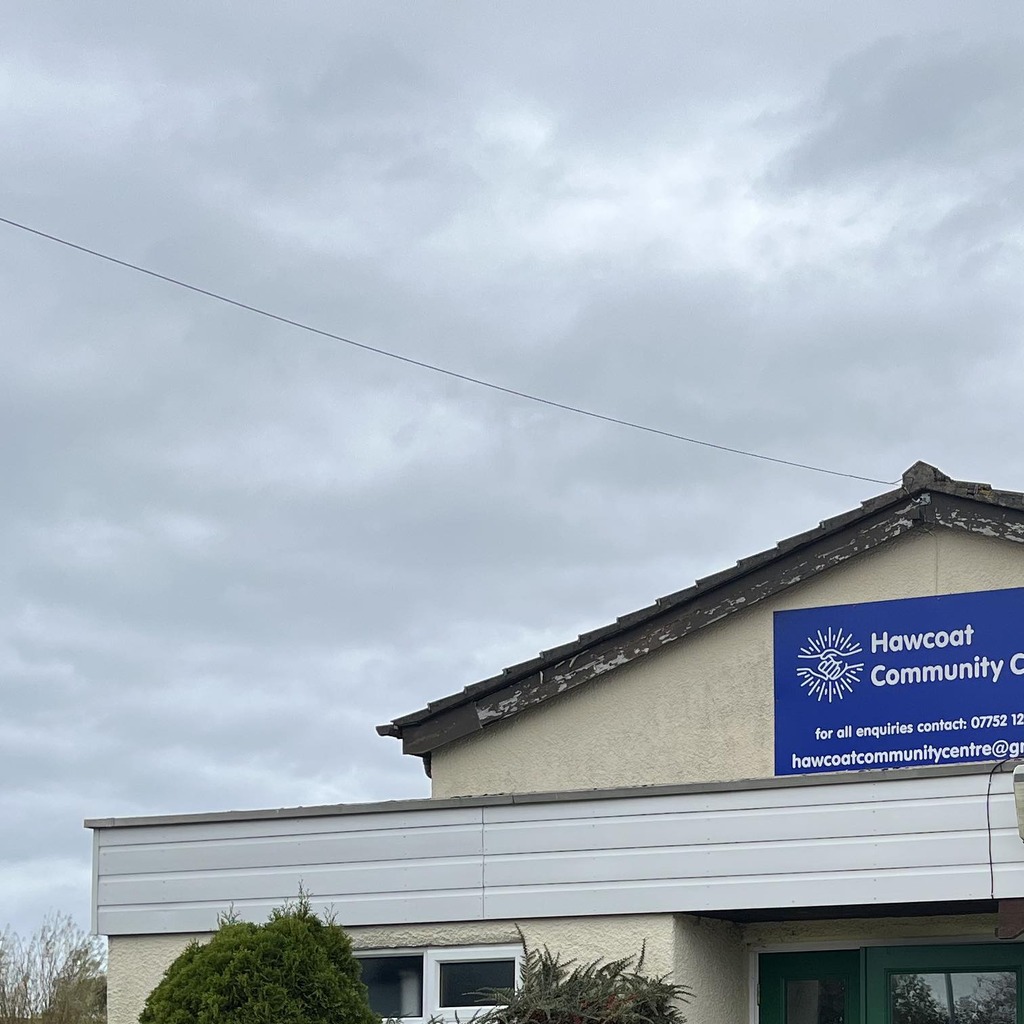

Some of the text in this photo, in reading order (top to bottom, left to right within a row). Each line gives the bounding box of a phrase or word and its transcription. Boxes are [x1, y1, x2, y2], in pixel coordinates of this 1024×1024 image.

[871, 624, 975, 654] Hawcoat
[870, 655, 1004, 687] Community
[815, 727, 833, 740] for
[836, 725, 852, 738] all
[856, 721, 914, 738] enquiries
[917, 717, 967, 732] contact:
[970, 714, 1008, 729] 07752
